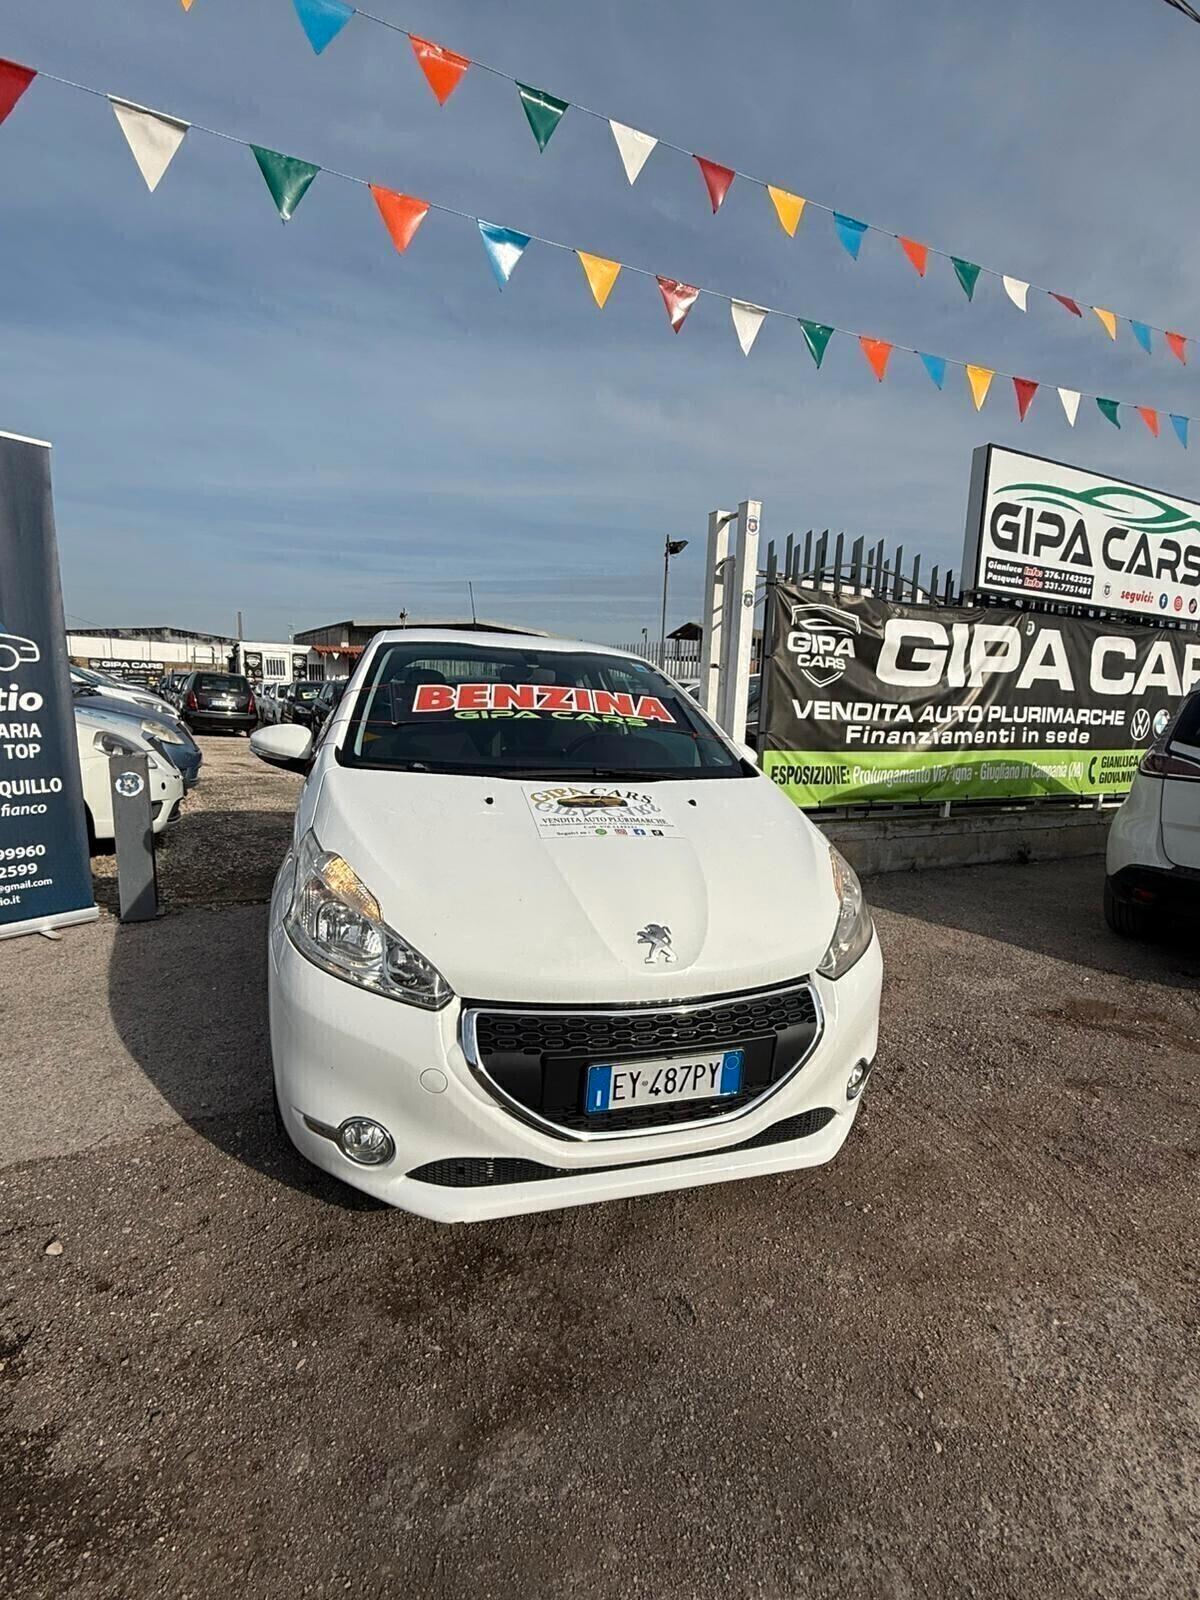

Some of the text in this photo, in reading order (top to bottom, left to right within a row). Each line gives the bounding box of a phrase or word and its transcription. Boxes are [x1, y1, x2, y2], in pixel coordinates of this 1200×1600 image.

[990, 501, 1200, 587] GIPA CARS
[988, 560, 1022, 574] Gianluca
[987, 572, 1023, 585] Pasquale
[1120, 590, 1154, 604] seguici:
[787, 631, 856, 658] GIPA
[797, 654, 846, 670] CARS
[875, 619, 1075, 691] GIPA
[101, 660, 164, 670] GIPA CARS
[412, 683, 677, 724] BENZINA
[454, 710, 649, 728] GIPA CARS
[792, 699, 1126, 726] VENDITA AUTO PLURIMARCHE
[845, 725, 1090, 745] Finanziamenti in sede
[3, 743, 41, 760] TOP
[1101, 755, 1139, 768] GIANLUCA
[771, 765, 850, 785] ESPOSIZIONE:
[852, 766, 931, 787] Prolungamento
[981, 762, 1020, 783] Giugliano
[530, 787, 653, 804] GIPA CARS
[1, 803, 47, 817] fianco
[584, 816, 607, 824] AUTO
[608, 817, 668, 825] PLURIMARCHE
[612, 1062, 721, 1100] EY 487PY
